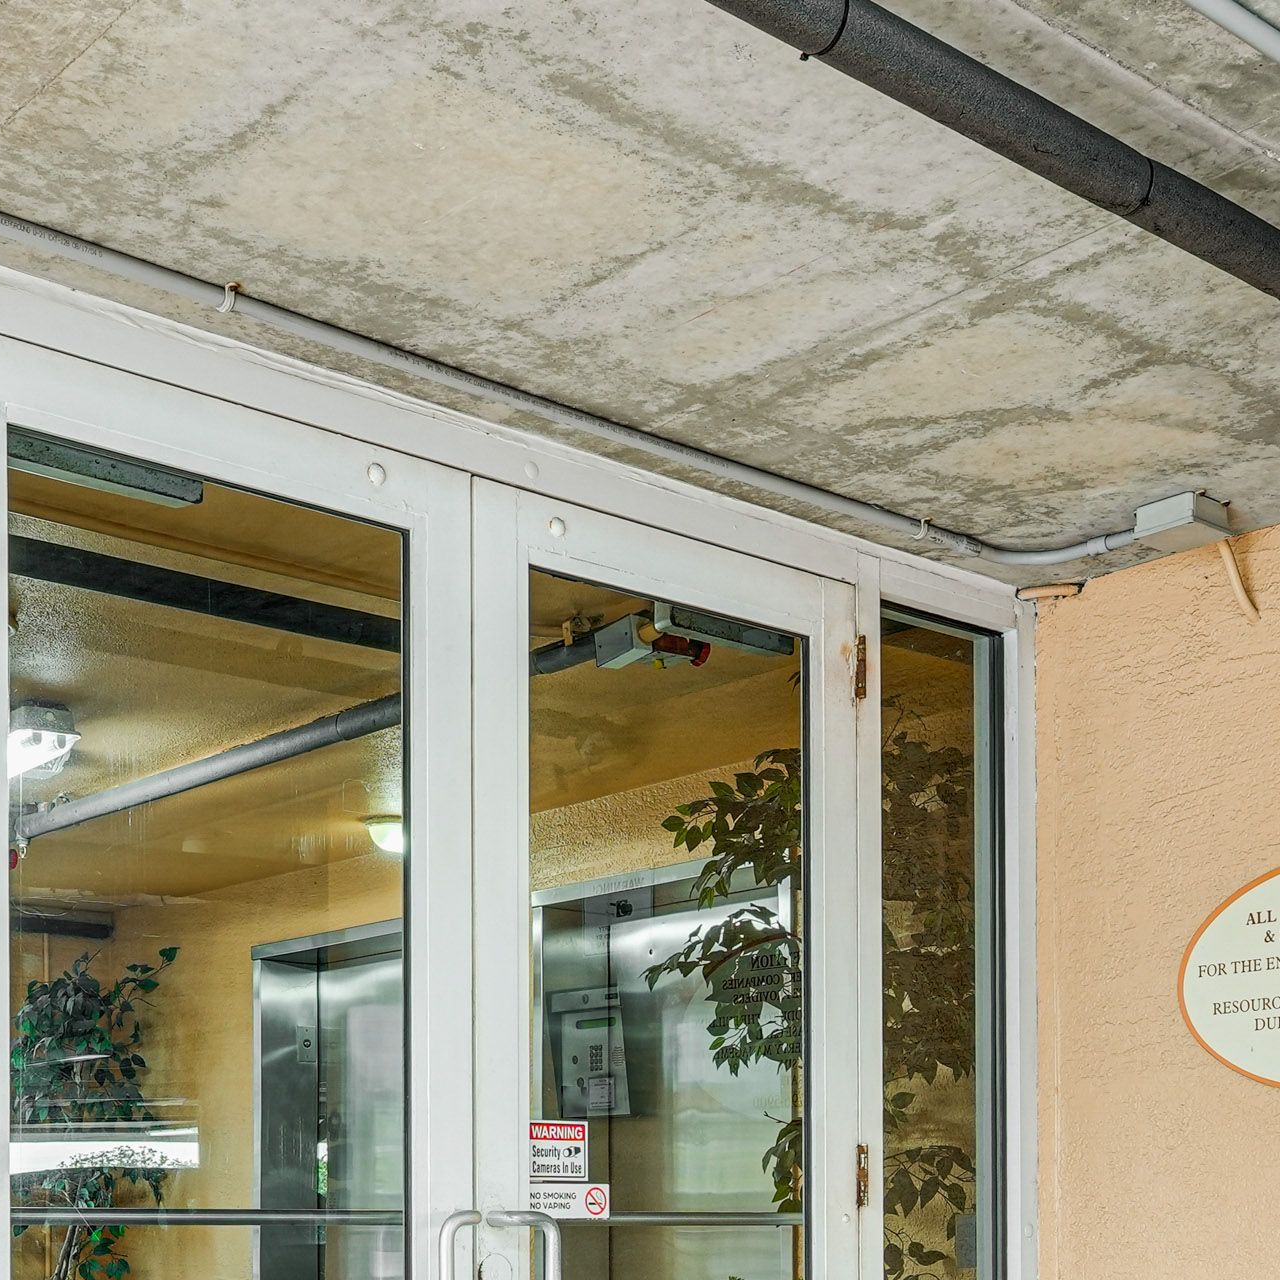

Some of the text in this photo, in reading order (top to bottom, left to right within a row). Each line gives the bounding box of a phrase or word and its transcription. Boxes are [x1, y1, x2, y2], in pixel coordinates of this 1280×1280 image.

[1246, 908, 1277, 927] ALL
[1264, 929, 1275, 944] &
[1198, 962, 1227, 978] FOR
[1231, 959, 1262, 976] THE
[531, 1125, 583, 1139] WARNING
[532, 1145, 561, 1160] Security
[532, 1161, 582, 1174] Cameras In Use
[530, 1192, 577, 1200] NO SMOKING
[530, 1202, 571, 1210] NO VAPING
